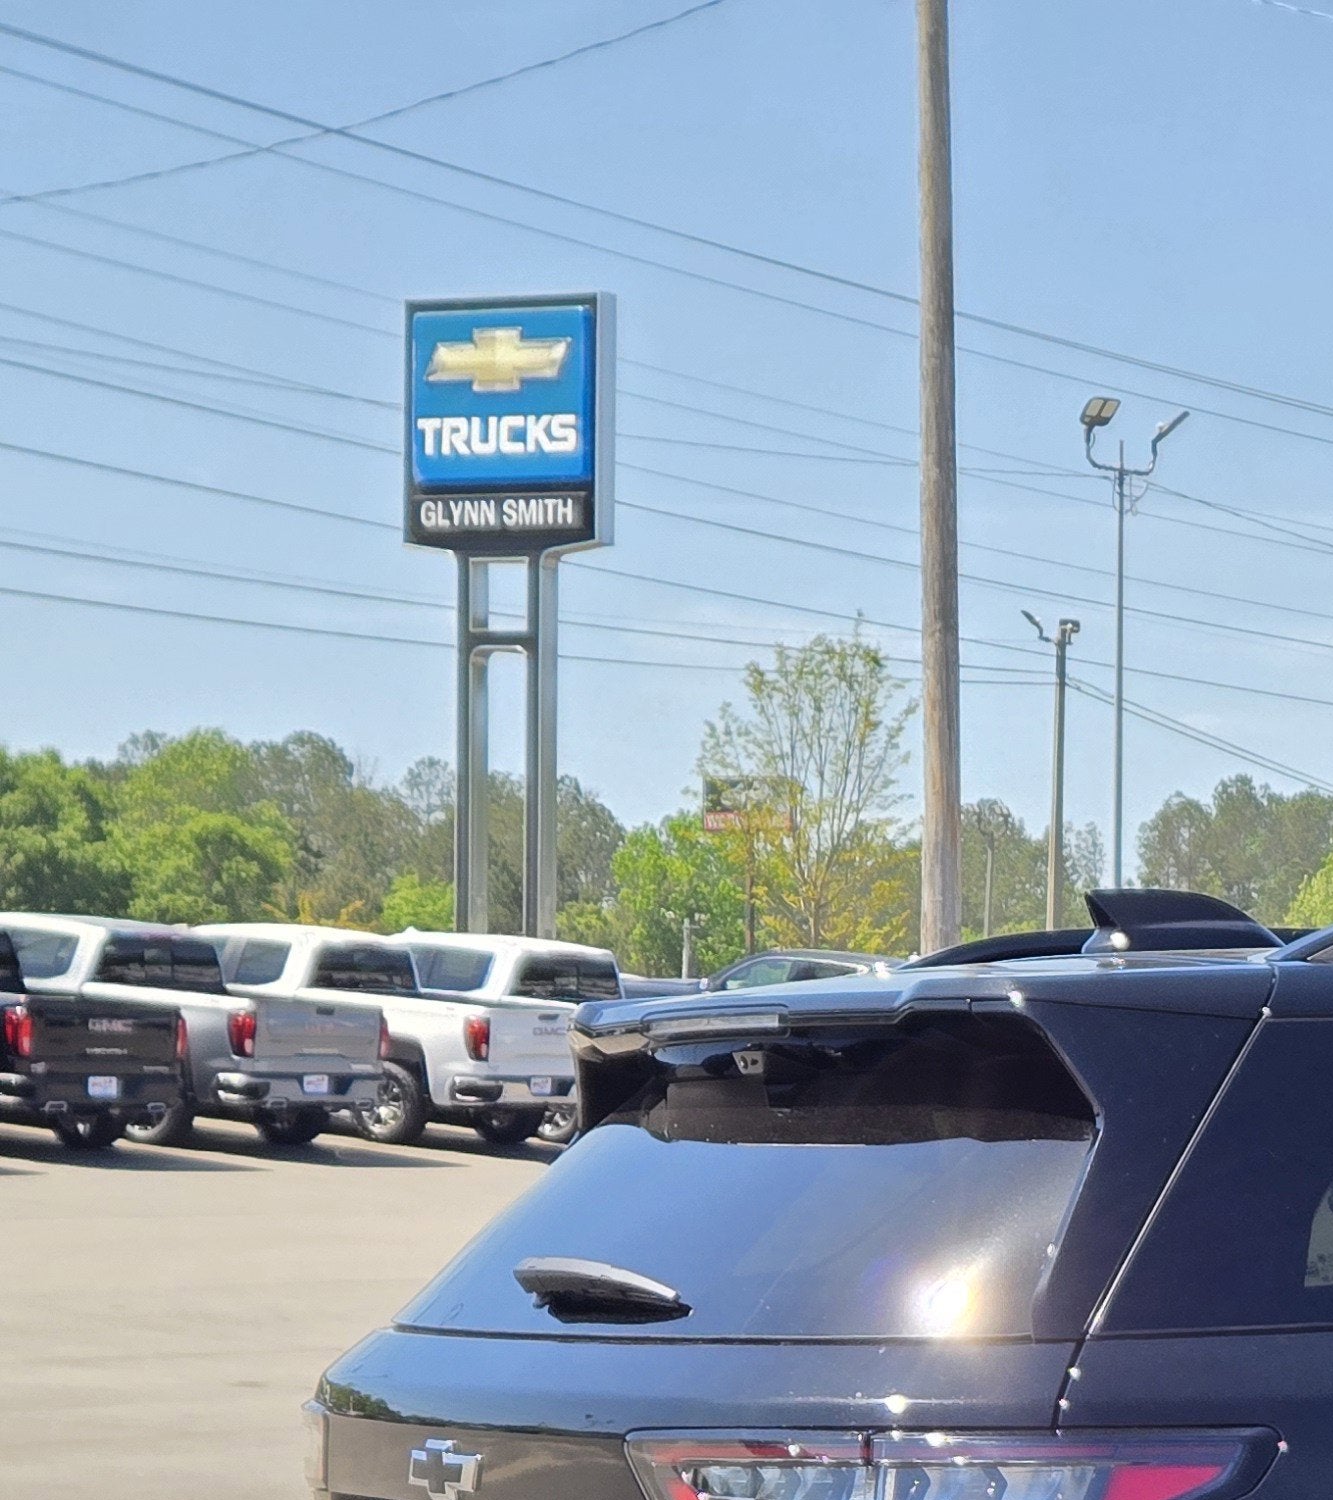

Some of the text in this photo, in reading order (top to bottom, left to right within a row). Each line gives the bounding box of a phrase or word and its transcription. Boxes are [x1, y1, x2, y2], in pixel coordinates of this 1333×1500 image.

[417, 414, 578, 456] TRUCKS
[420, 498, 574, 528] GLYNN SMITH
